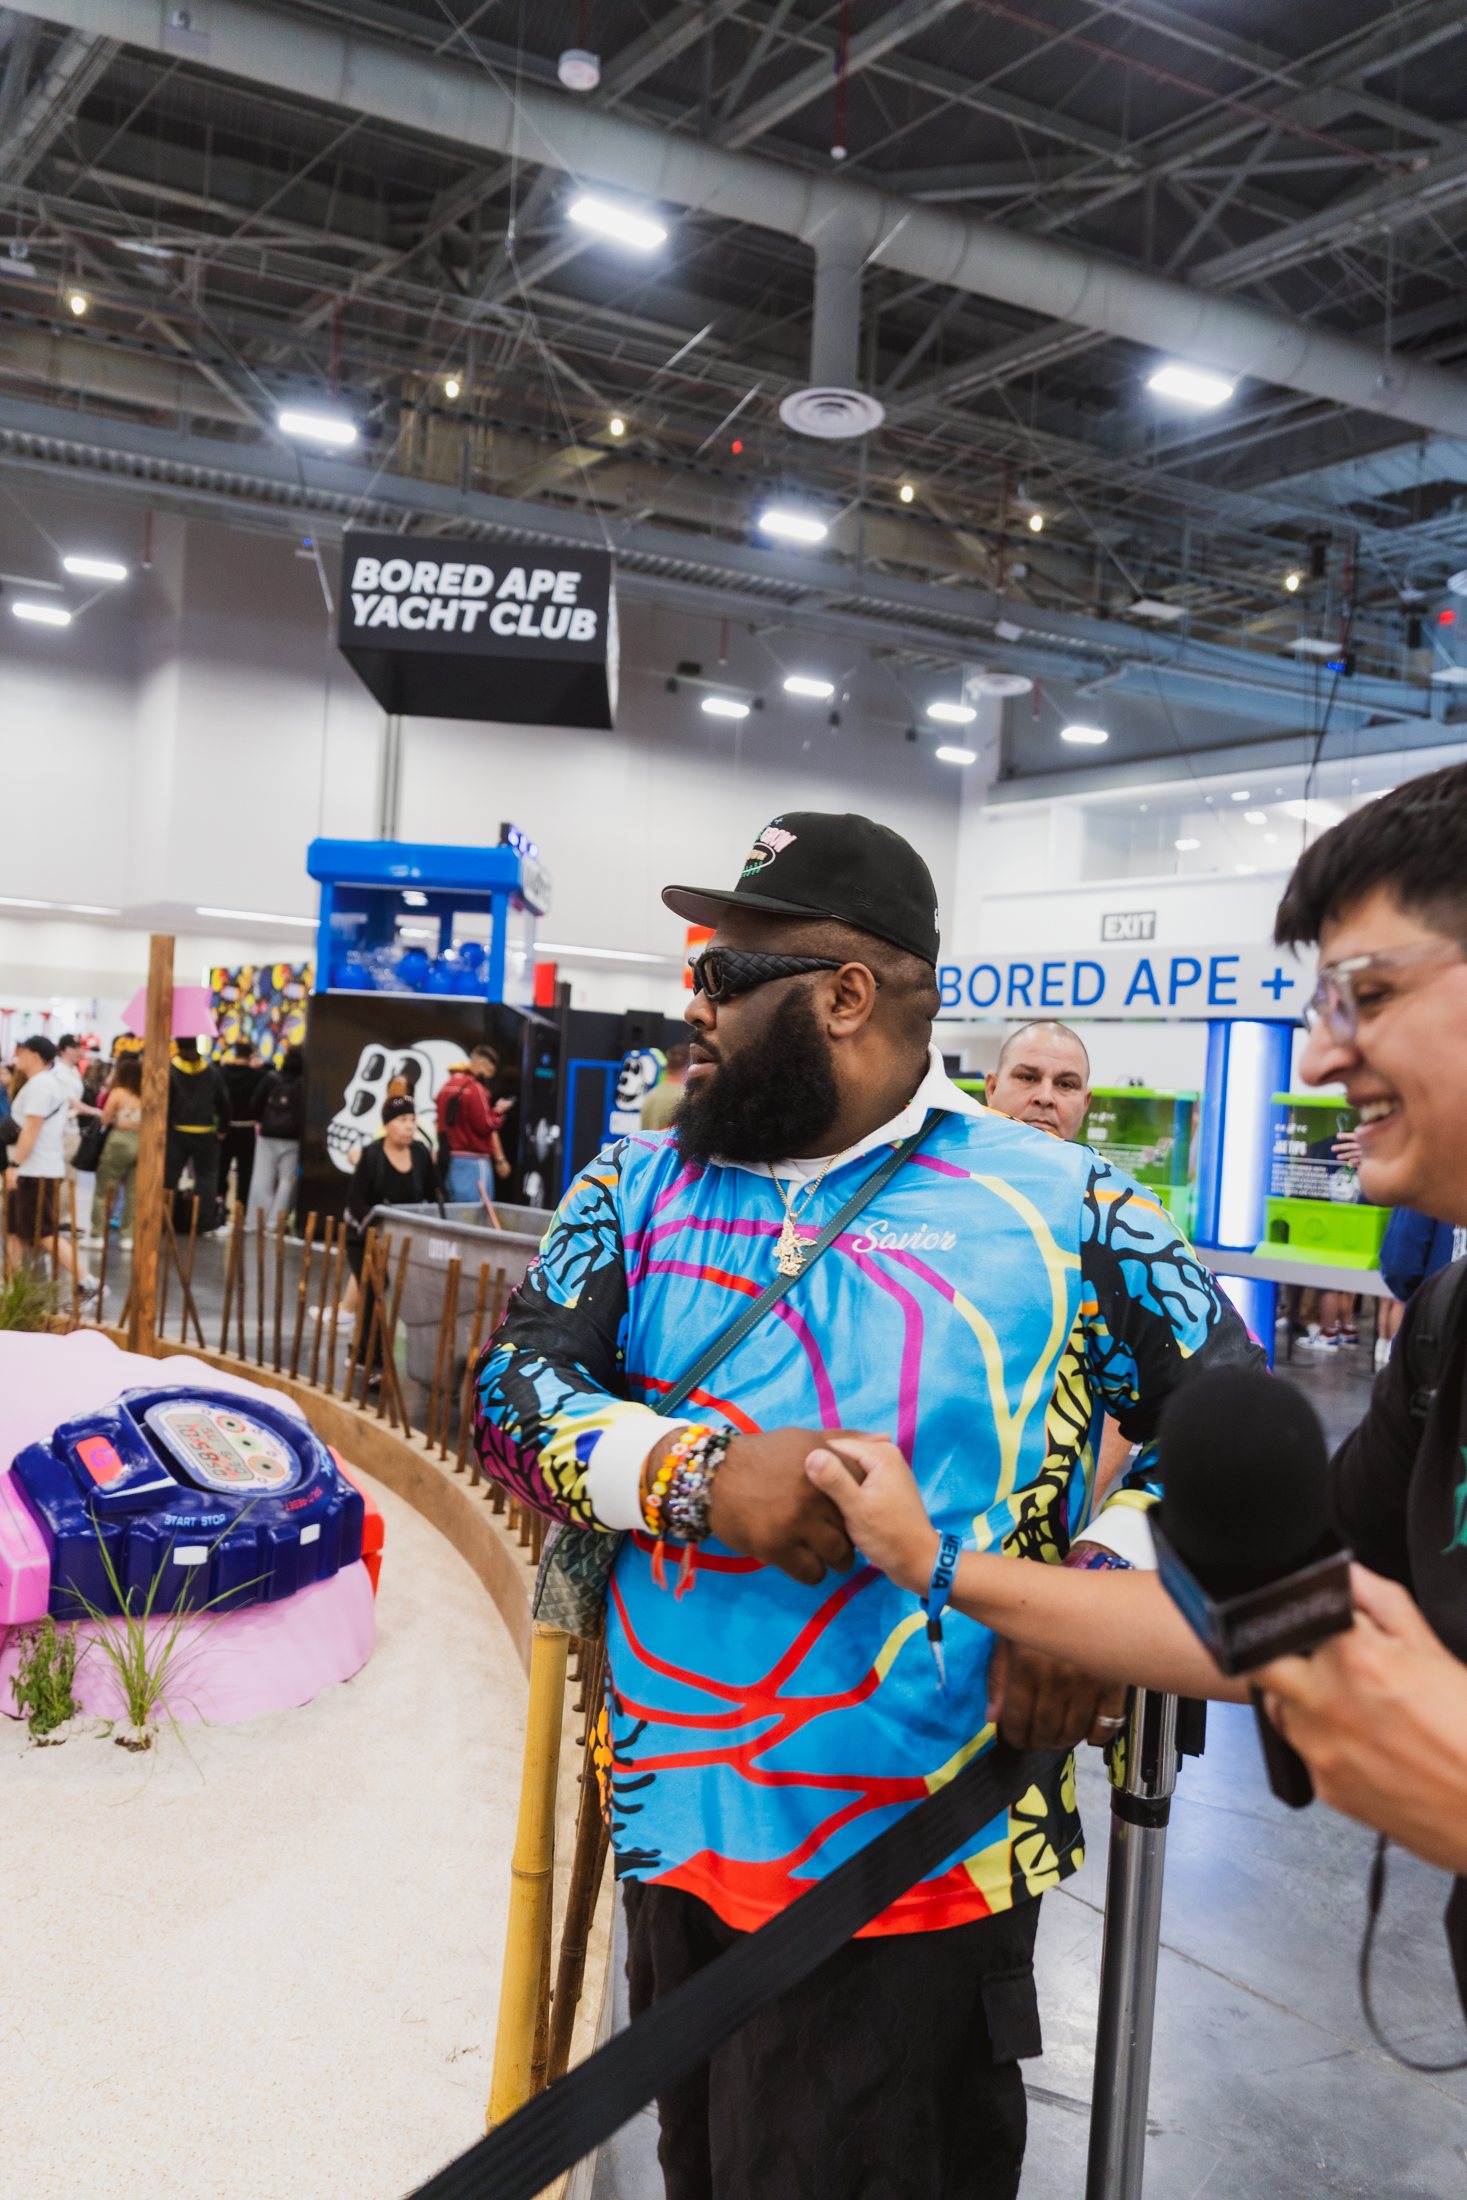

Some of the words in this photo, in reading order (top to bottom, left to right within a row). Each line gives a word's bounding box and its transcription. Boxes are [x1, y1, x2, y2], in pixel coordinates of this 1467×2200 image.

[351, 556, 494, 597] BORED
[495, 566, 582, 604] APE
[351, 592, 488, 633] YACHT
[489, 601, 598, 641] CLUB
[1104, 913, 1154, 940] EXIT
[939, 961, 1106, 1008] BORED
[1123, 955, 1240, 1006] APE
[851, 1219, 957, 1253] Savior
[164, 1513, 197, 1527] START
[200, 1513, 227, 1528] STOP
[931, 1532, 960, 1589] MEDIA
